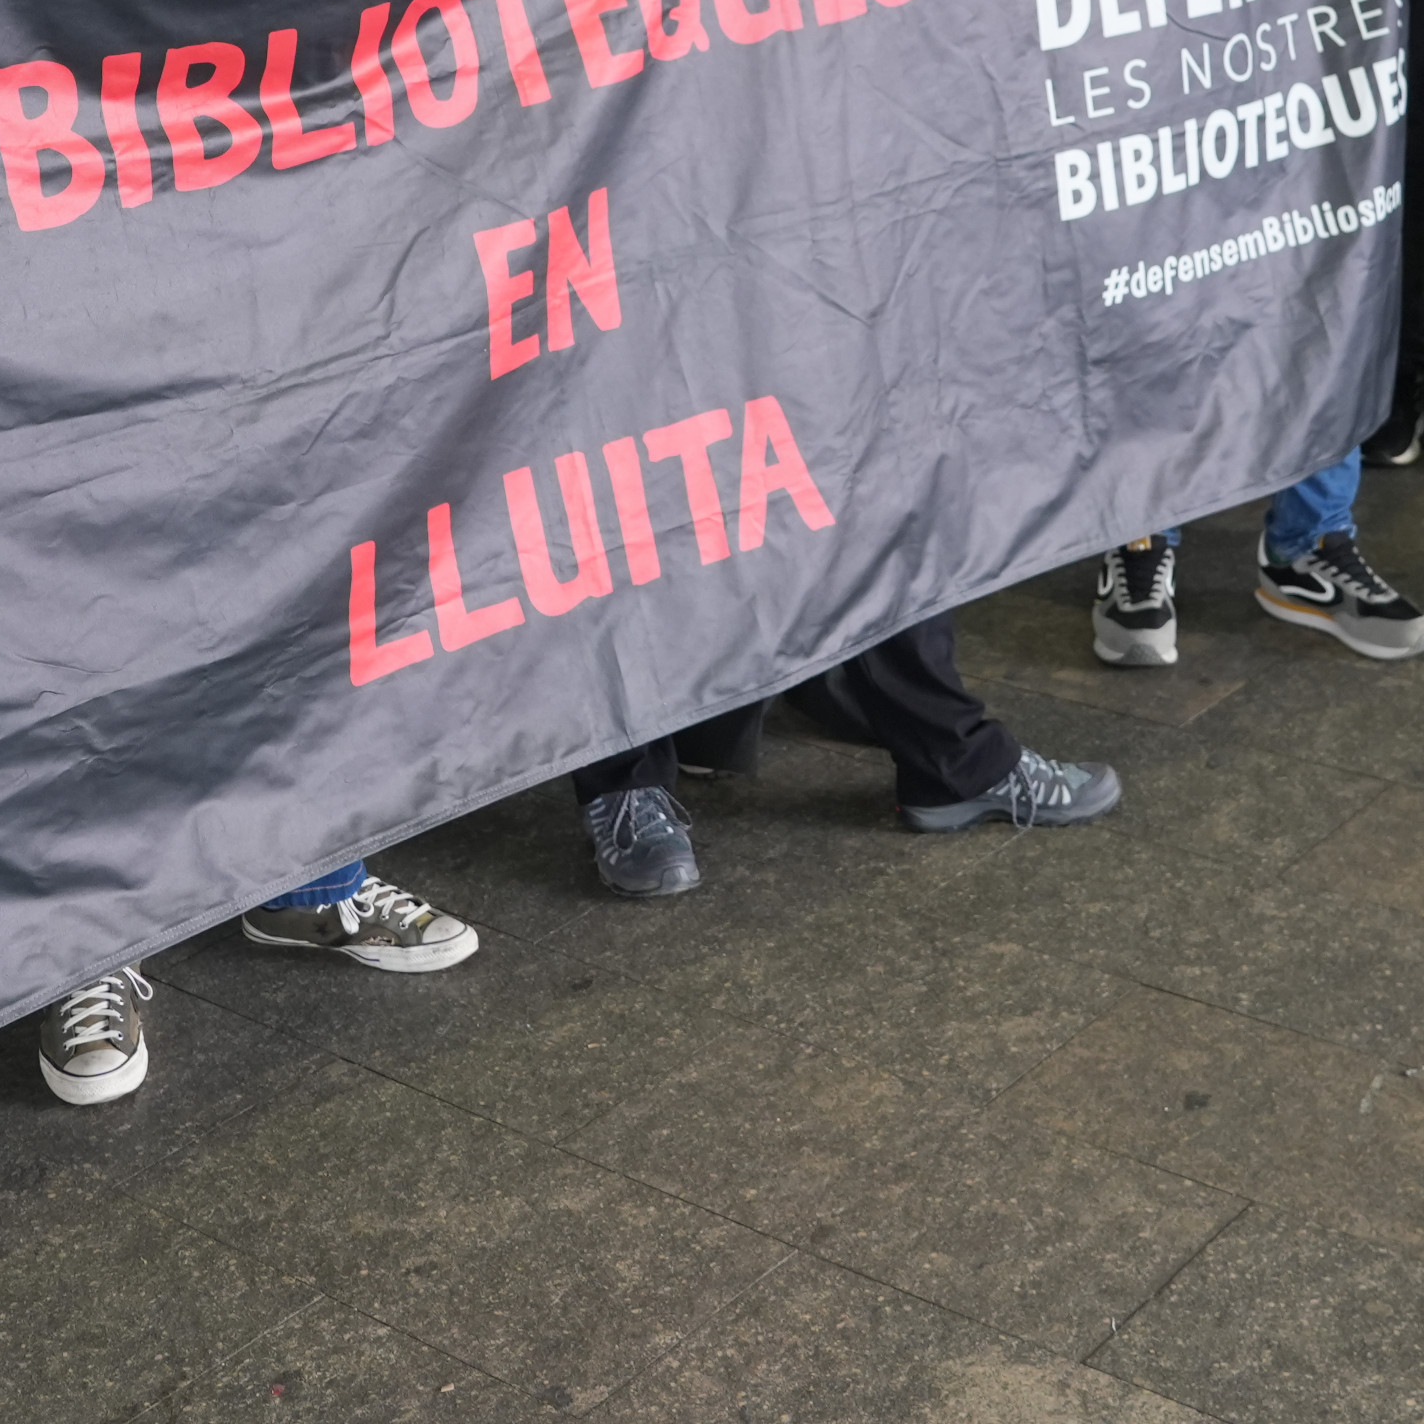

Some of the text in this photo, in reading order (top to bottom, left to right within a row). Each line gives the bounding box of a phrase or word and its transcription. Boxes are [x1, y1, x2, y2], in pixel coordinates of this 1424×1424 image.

[1045, 58, 1153, 127] LES
[472, 186, 623, 382] EN
[1101, 180, 1404, 308] #defensemBibliosBcn
[347, 394, 837, 688] LLUITA
